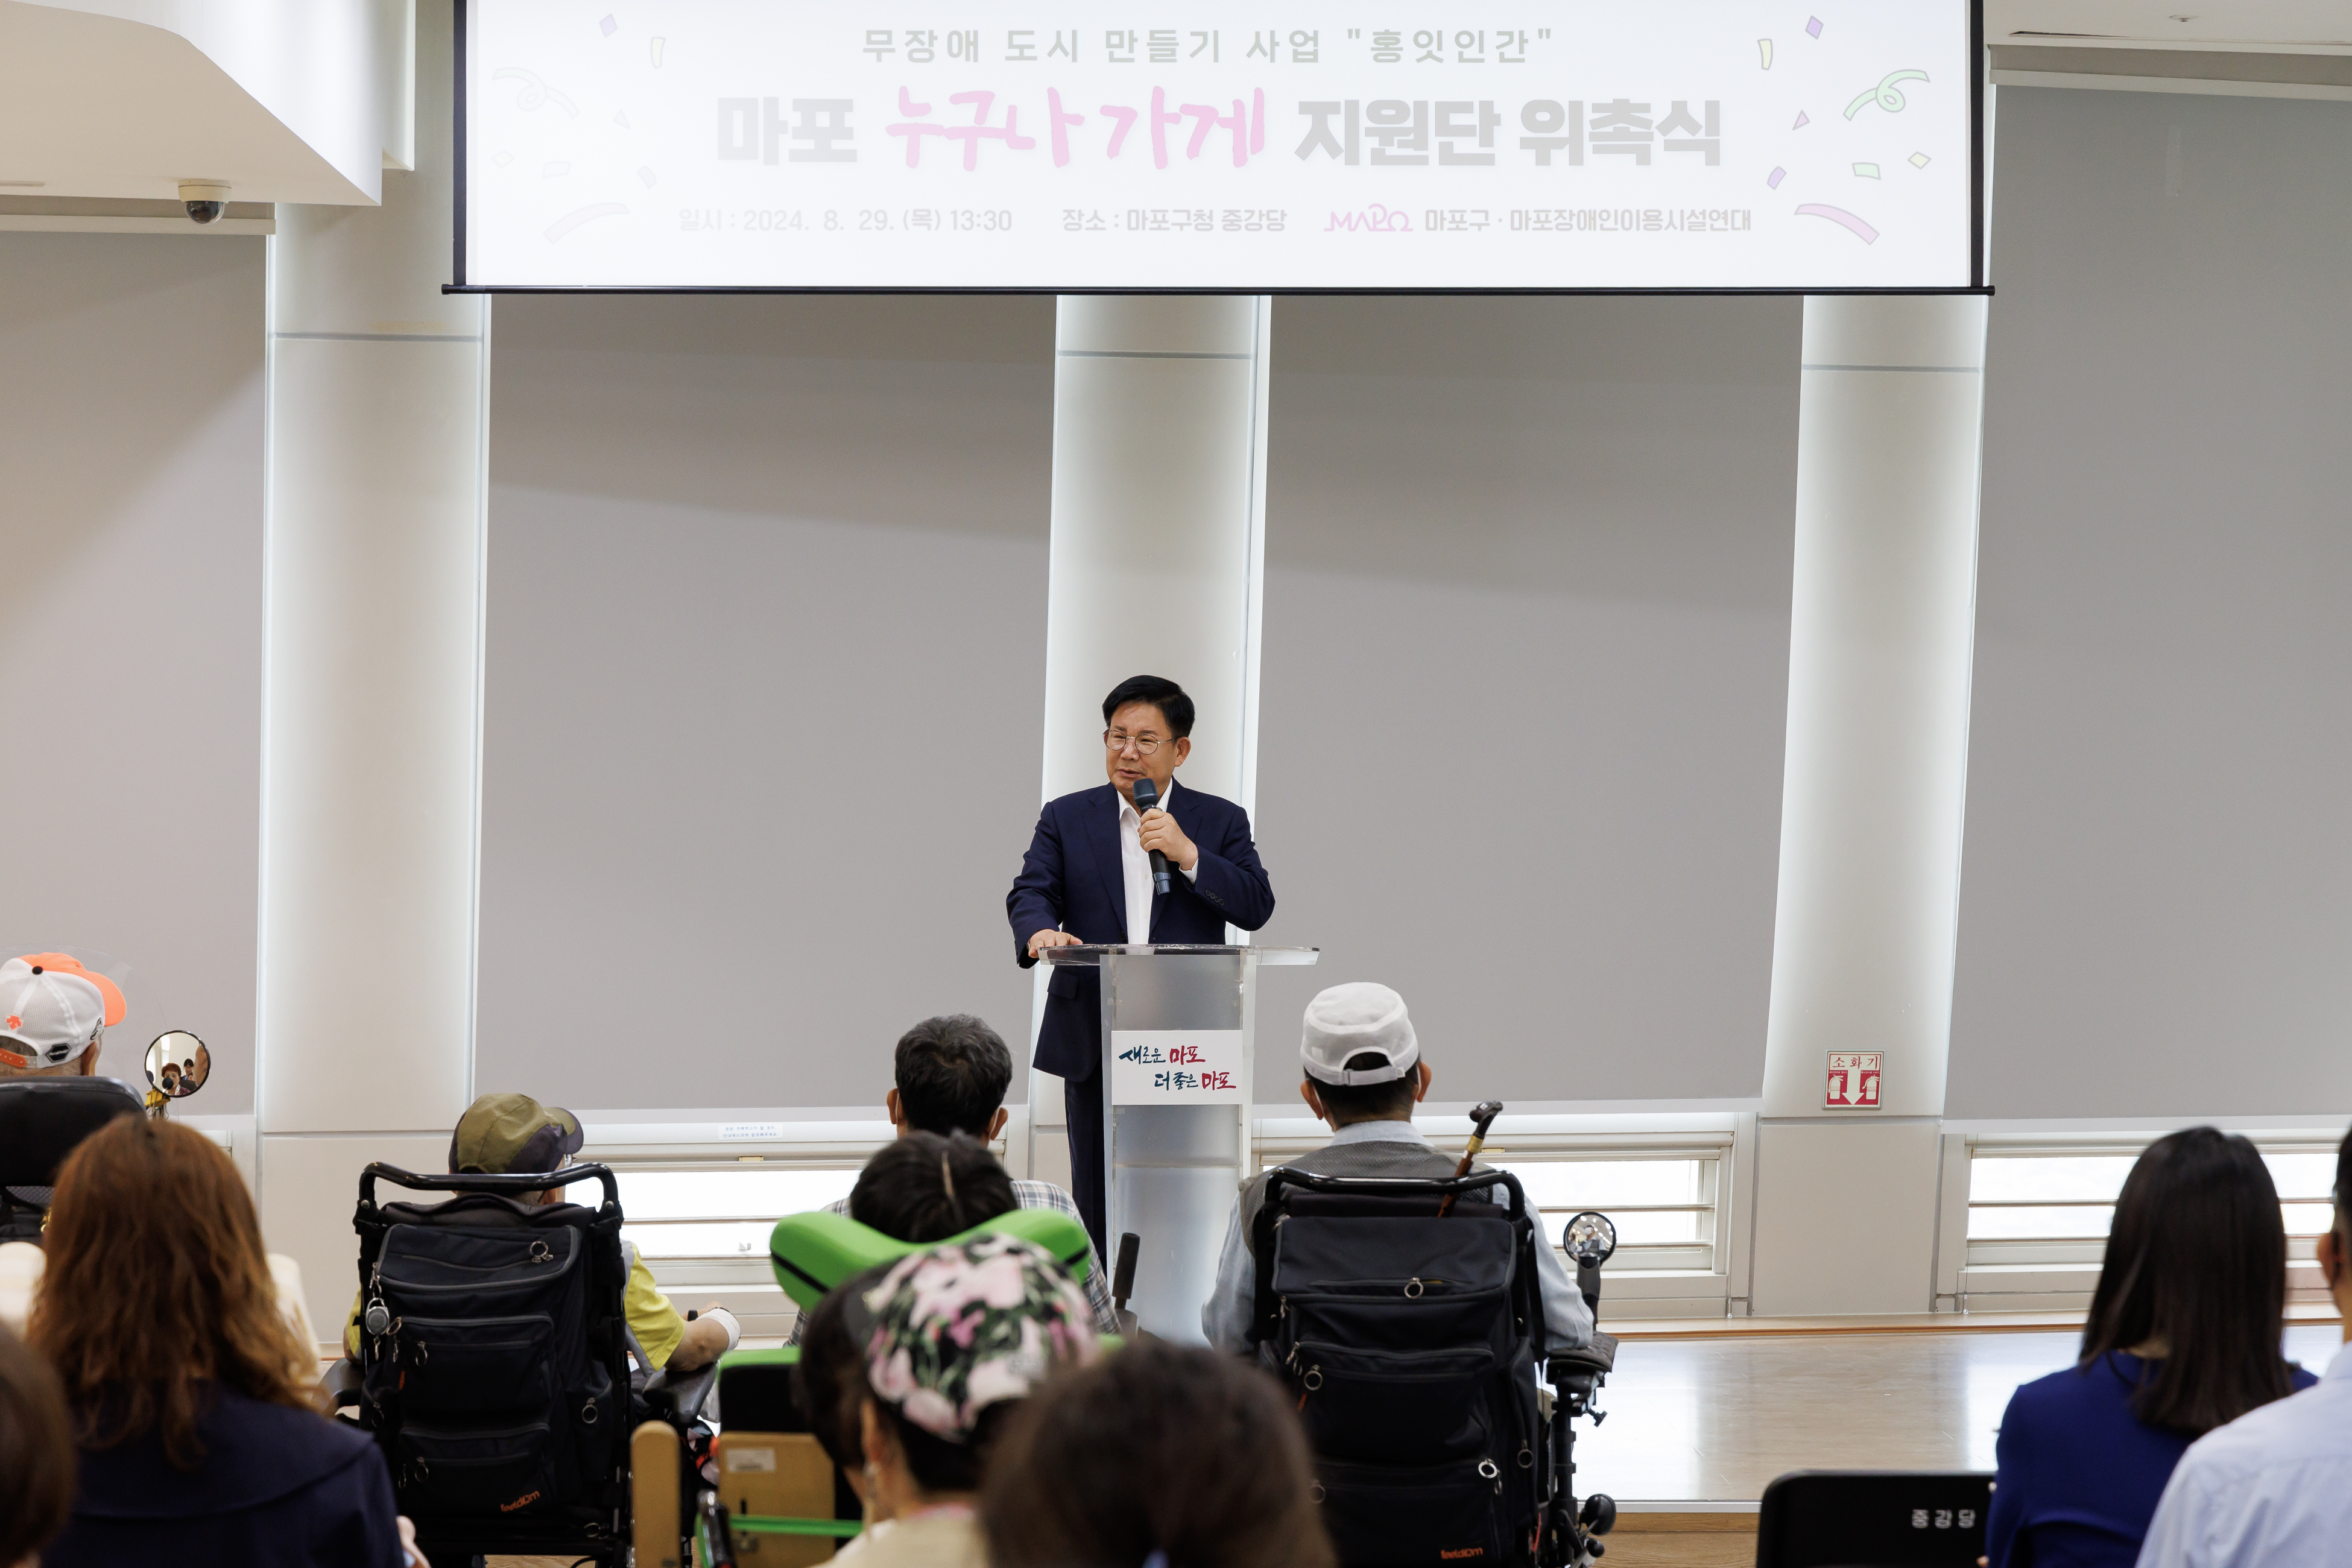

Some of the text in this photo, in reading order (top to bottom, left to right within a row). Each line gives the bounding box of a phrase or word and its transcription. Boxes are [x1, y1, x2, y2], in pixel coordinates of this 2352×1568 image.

[862, 28, 1552, 64] 무장애 도시 만들기 사업 "홍잇인간"
[716, 96, 858, 166] 마포
[1294, 98, 1502, 167] 지원단
[1519, 98, 1721, 167] 위촉식
[678, 209, 722, 232] 일시
[743, 209, 809, 232] 2024.
[823, 209, 846, 232] 8.
[858, 209, 895, 232] 29.
[902, 208, 942, 232] (목)
[949, 209, 1013, 232] 13:30
[1061, 209, 1107, 232] 장소
[1126, 208, 1215, 232] 마포구청
[1221, 209, 1288, 233] 중강당
[1424, 209, 1491, 233] 마포구
[1509, 208, 1753, 233] 마포장애인이용시설연대
[1118, 1045, 1206, 1066] 새로운 마포
[1832, 1055, 1879, 1070] 소화기
[1154, 1070, 1237, 1091] 더 좋은 마포
[1912, 1509, 1976, 1529] 중강당
